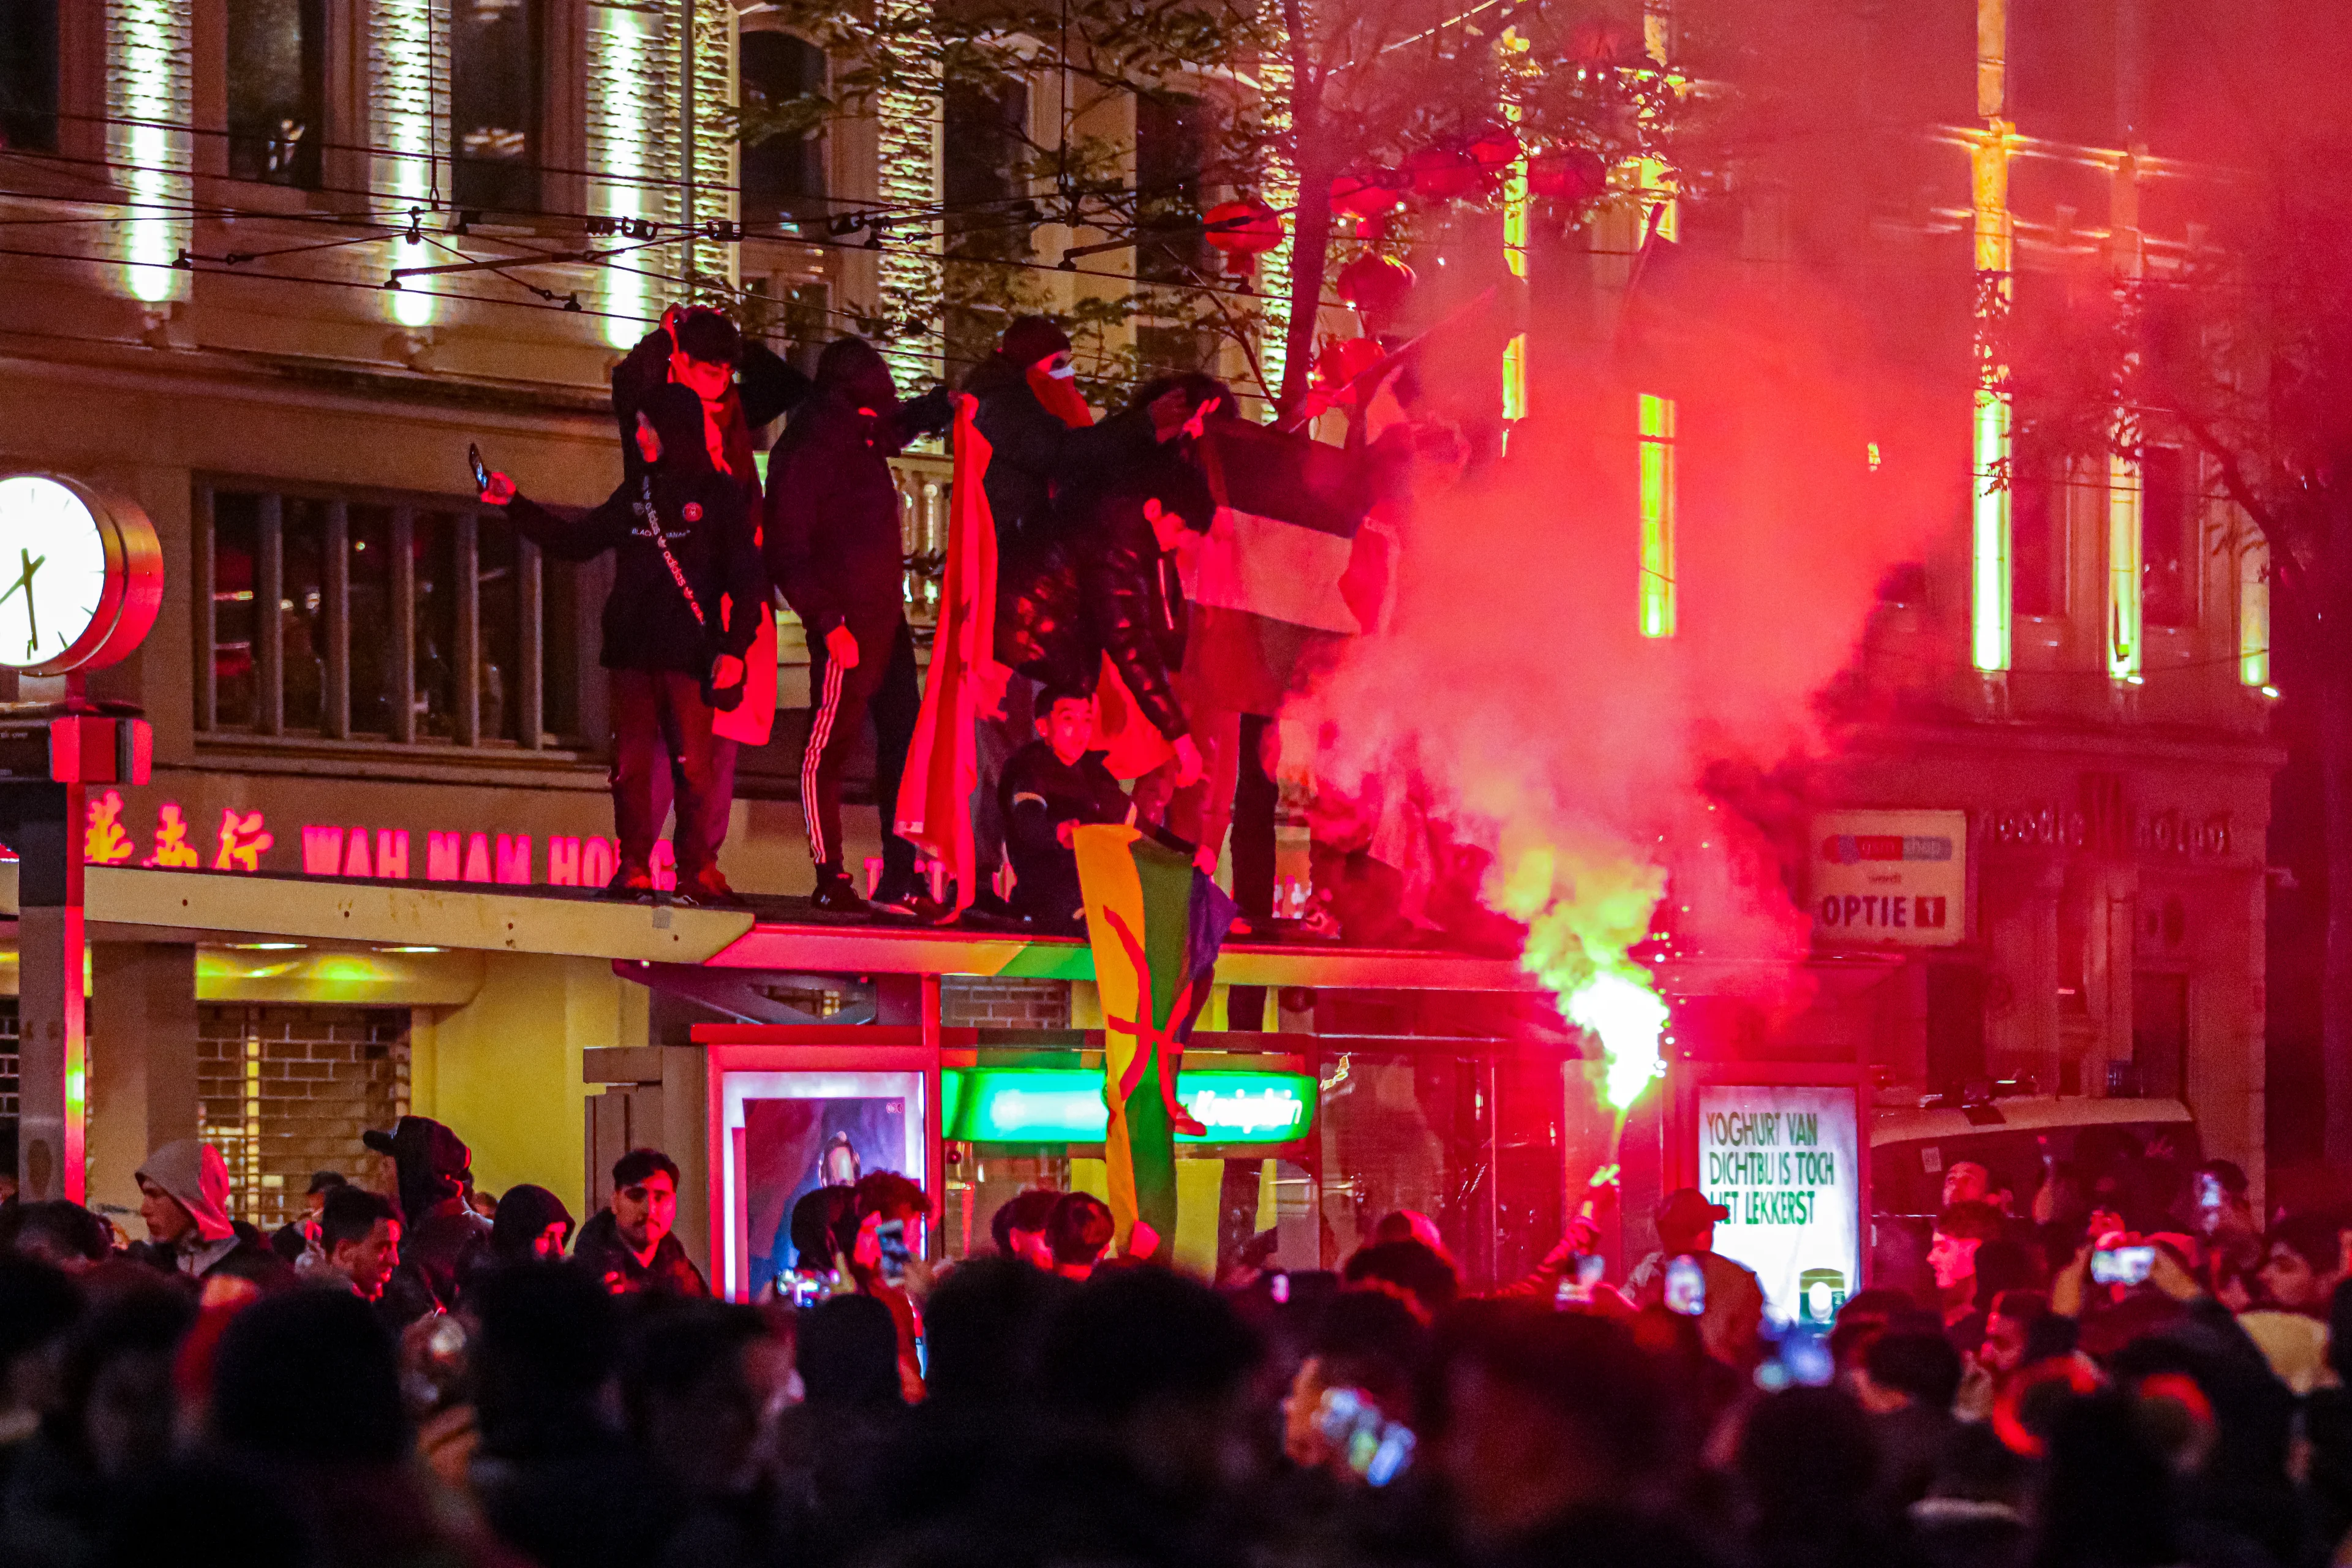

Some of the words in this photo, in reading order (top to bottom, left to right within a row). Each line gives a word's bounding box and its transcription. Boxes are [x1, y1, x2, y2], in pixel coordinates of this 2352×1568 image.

[663, 551, 686, 587] adidas
[302, 825, 410, 878] WAH
[426, 830, 532, 885] NAM
[547, 835, 677, 891] HOG
[1822, 895, 1907, 927] OPTIE
[1706, 1112, 1781, 1146] YOGHURT
[1786, 1112, 1818, 1146] VAN
[1779, 1152, 1791, 1185] IS
[1795, 1152, 1834, 1185] TOCH
[1746, 1191, 1815, 1225] LEKKERST
